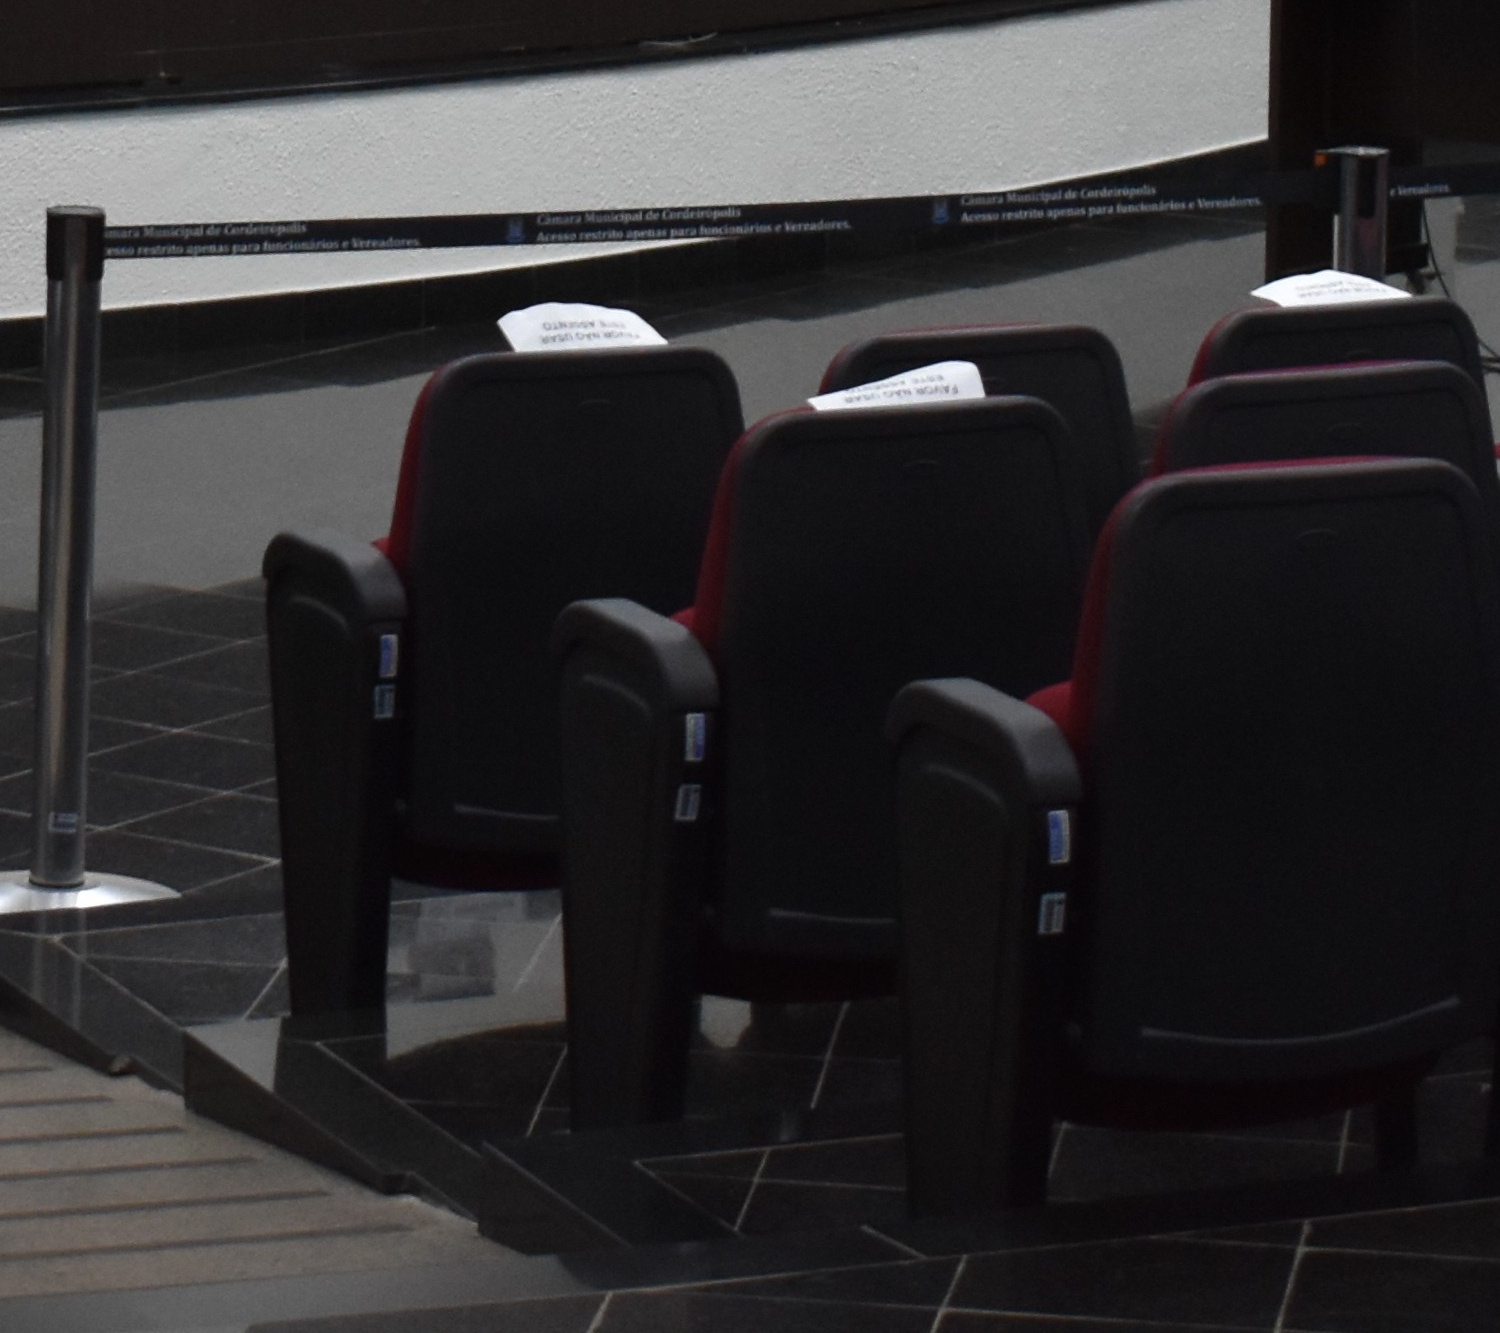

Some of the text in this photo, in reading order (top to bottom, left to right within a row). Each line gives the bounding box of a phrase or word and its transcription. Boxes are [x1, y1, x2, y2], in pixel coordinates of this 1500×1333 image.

[961, 184, 1157, 206] Câmara Municipal de Cordeirópolis
[536, 206, 742, 224] Câmara Municipal de Cordeirópolis
[961, 211, 1000, 222] Acesso
[1002, 208, 1045, 221] restrito
[1046, 207, 1087, 220] apenas
[1088, 205, 1114, 218] para
[1116, 199, 1187, 215] funcionários
[142, 224, 204, 240] Municipal
[206, 225, 223, 236] de
[224, 221, 307, 236] Cordeirópolis
[536, 232, 577, 242] Acesso
[578, 229, 624, 242] restrito
[625, 228, 667, 241] apenas
[669, 227, 697, 240] para
[699, 221, 772, 236] funcionários
[137, 243, 184, 255] restrito
[185, 243, 230, 257] apenas
[231, 241, 261, 255] para
[263, 237, 339, 252] funcionários
[542, 320, 595, 331] ASSENTO
[541, 332, 574, 344] USAR
